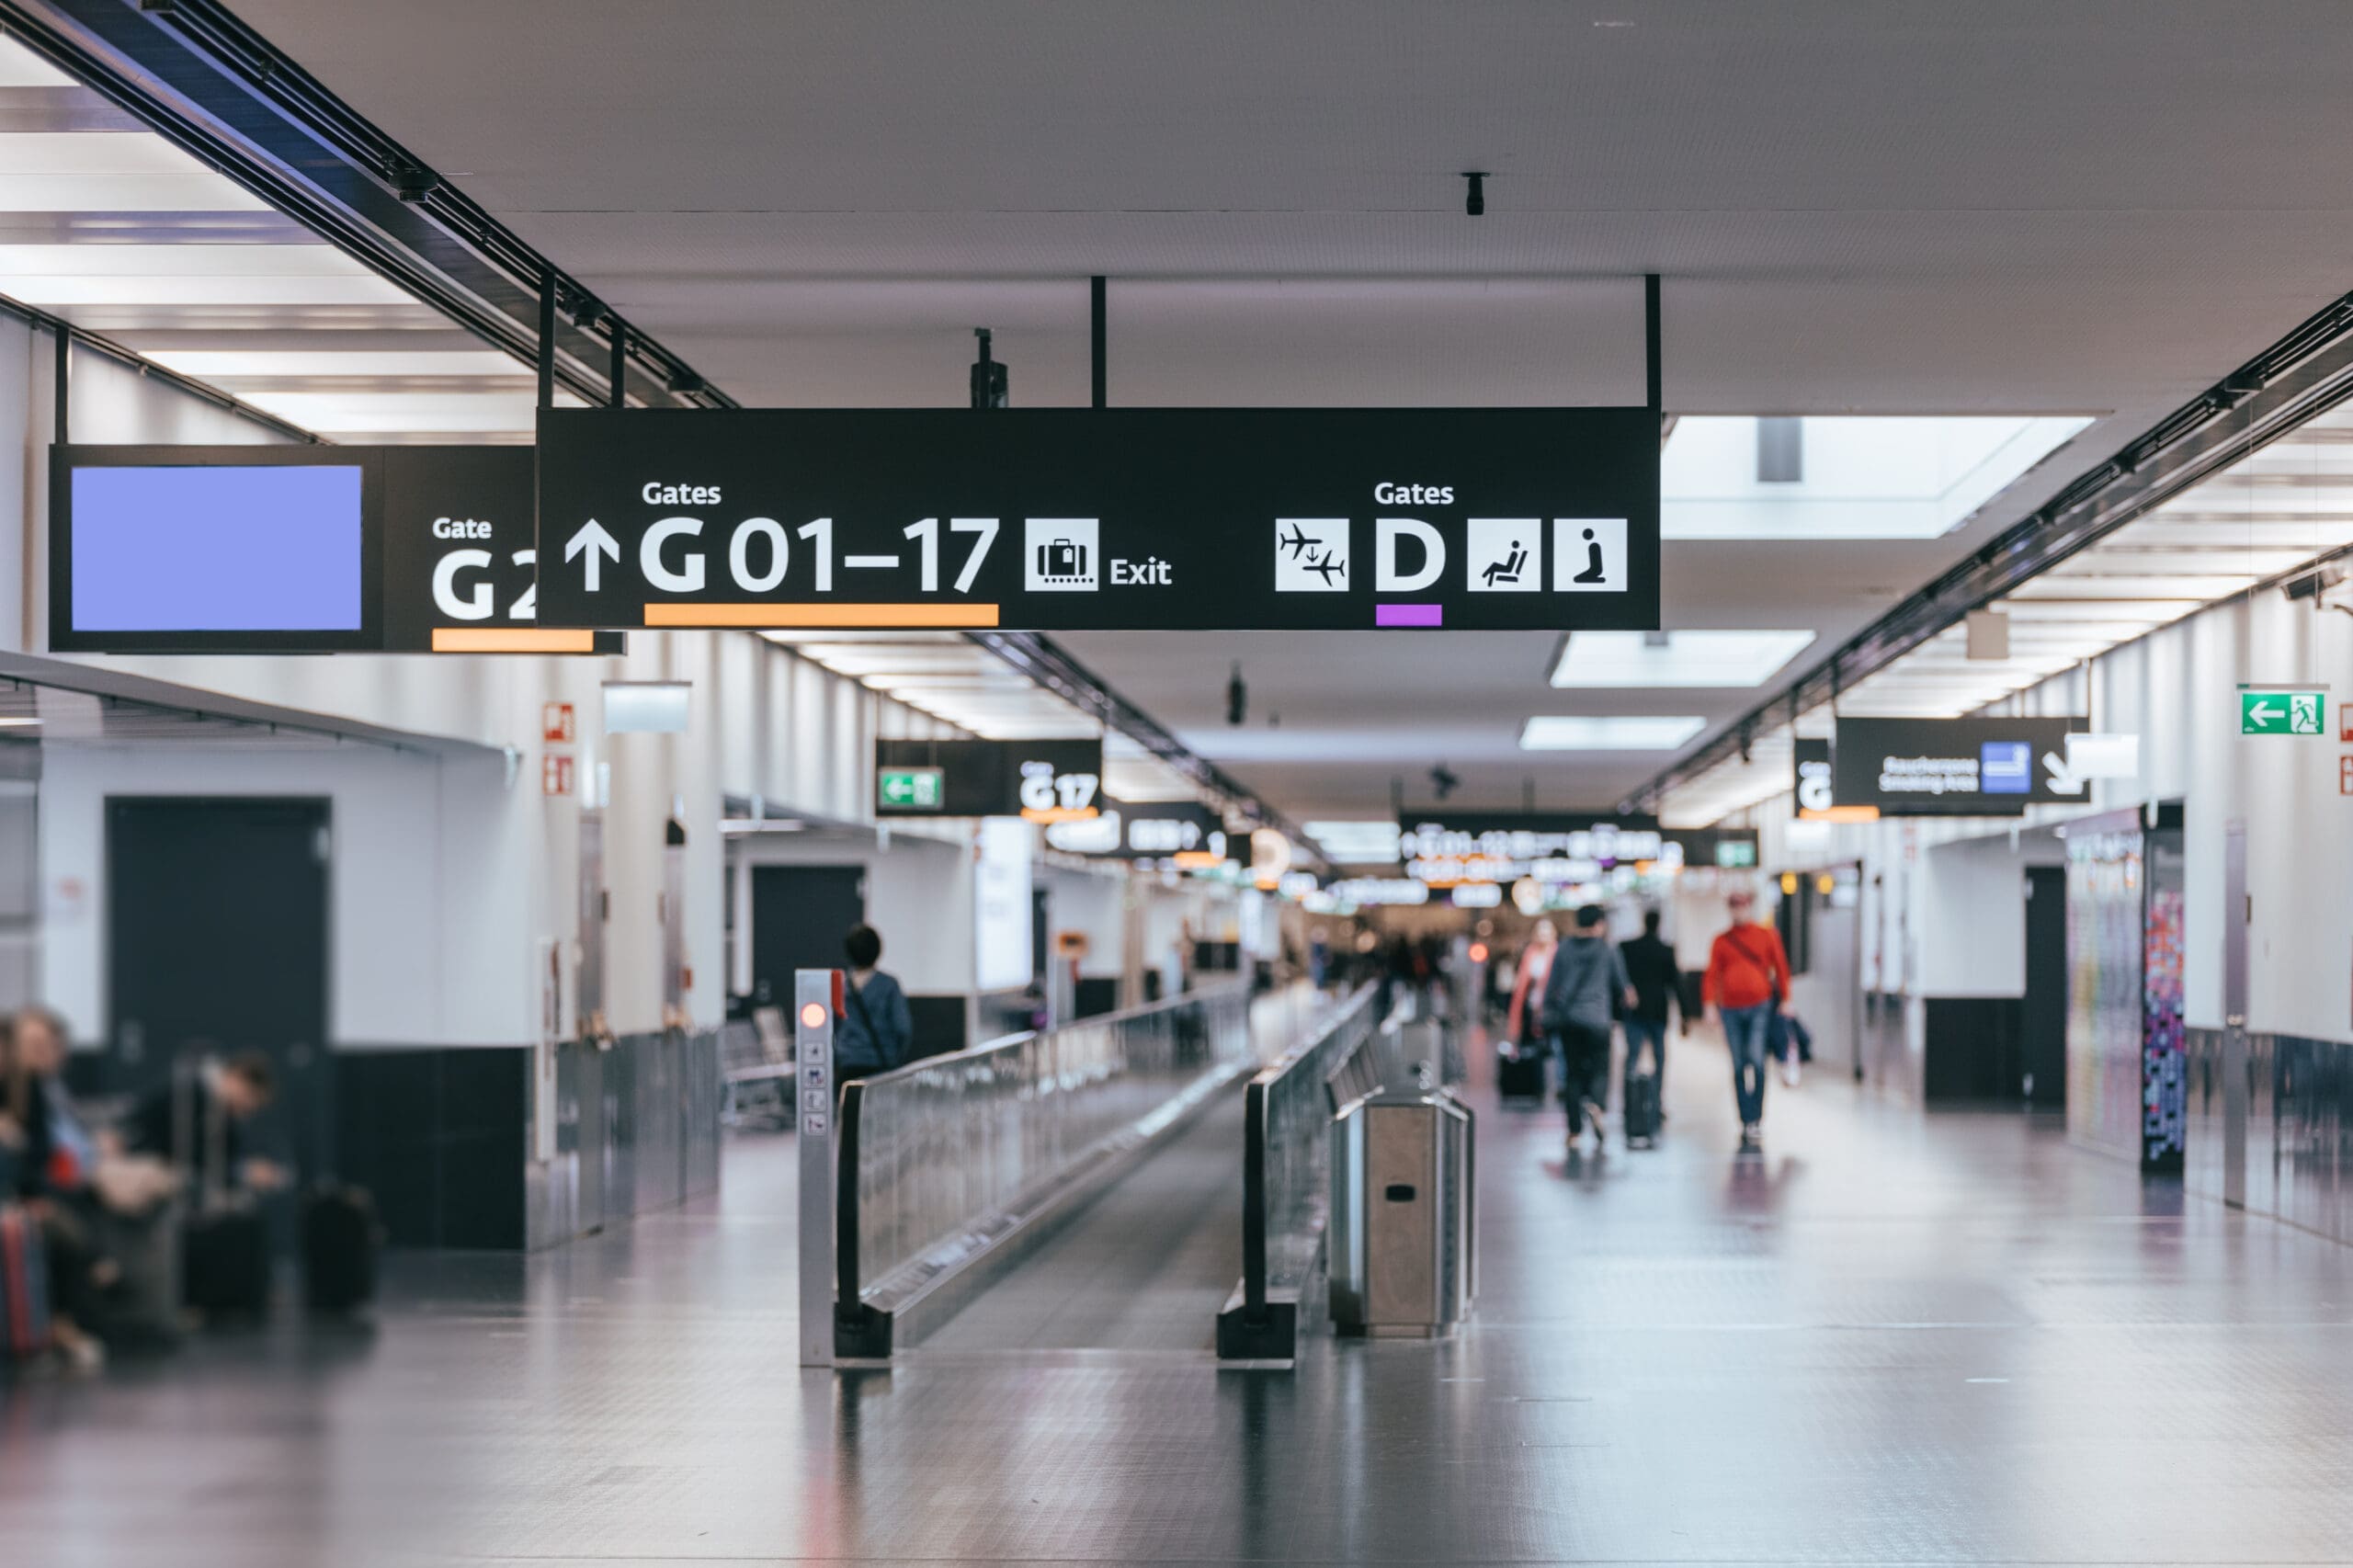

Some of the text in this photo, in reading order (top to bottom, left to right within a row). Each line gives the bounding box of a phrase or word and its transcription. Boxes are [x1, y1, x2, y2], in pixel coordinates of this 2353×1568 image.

[642, 482, 722, 505] Gates
[1374, 482, 1454, 505] Gates
[432, 517, 493, 540] Gate
[639, 517, 706, 593] G
[1110, 556, 1173, 585] Exit
[1375, 517, 1446, 592] D
[432, 549, 494, 620] G
[1056, 774, 1099, 811] 17
